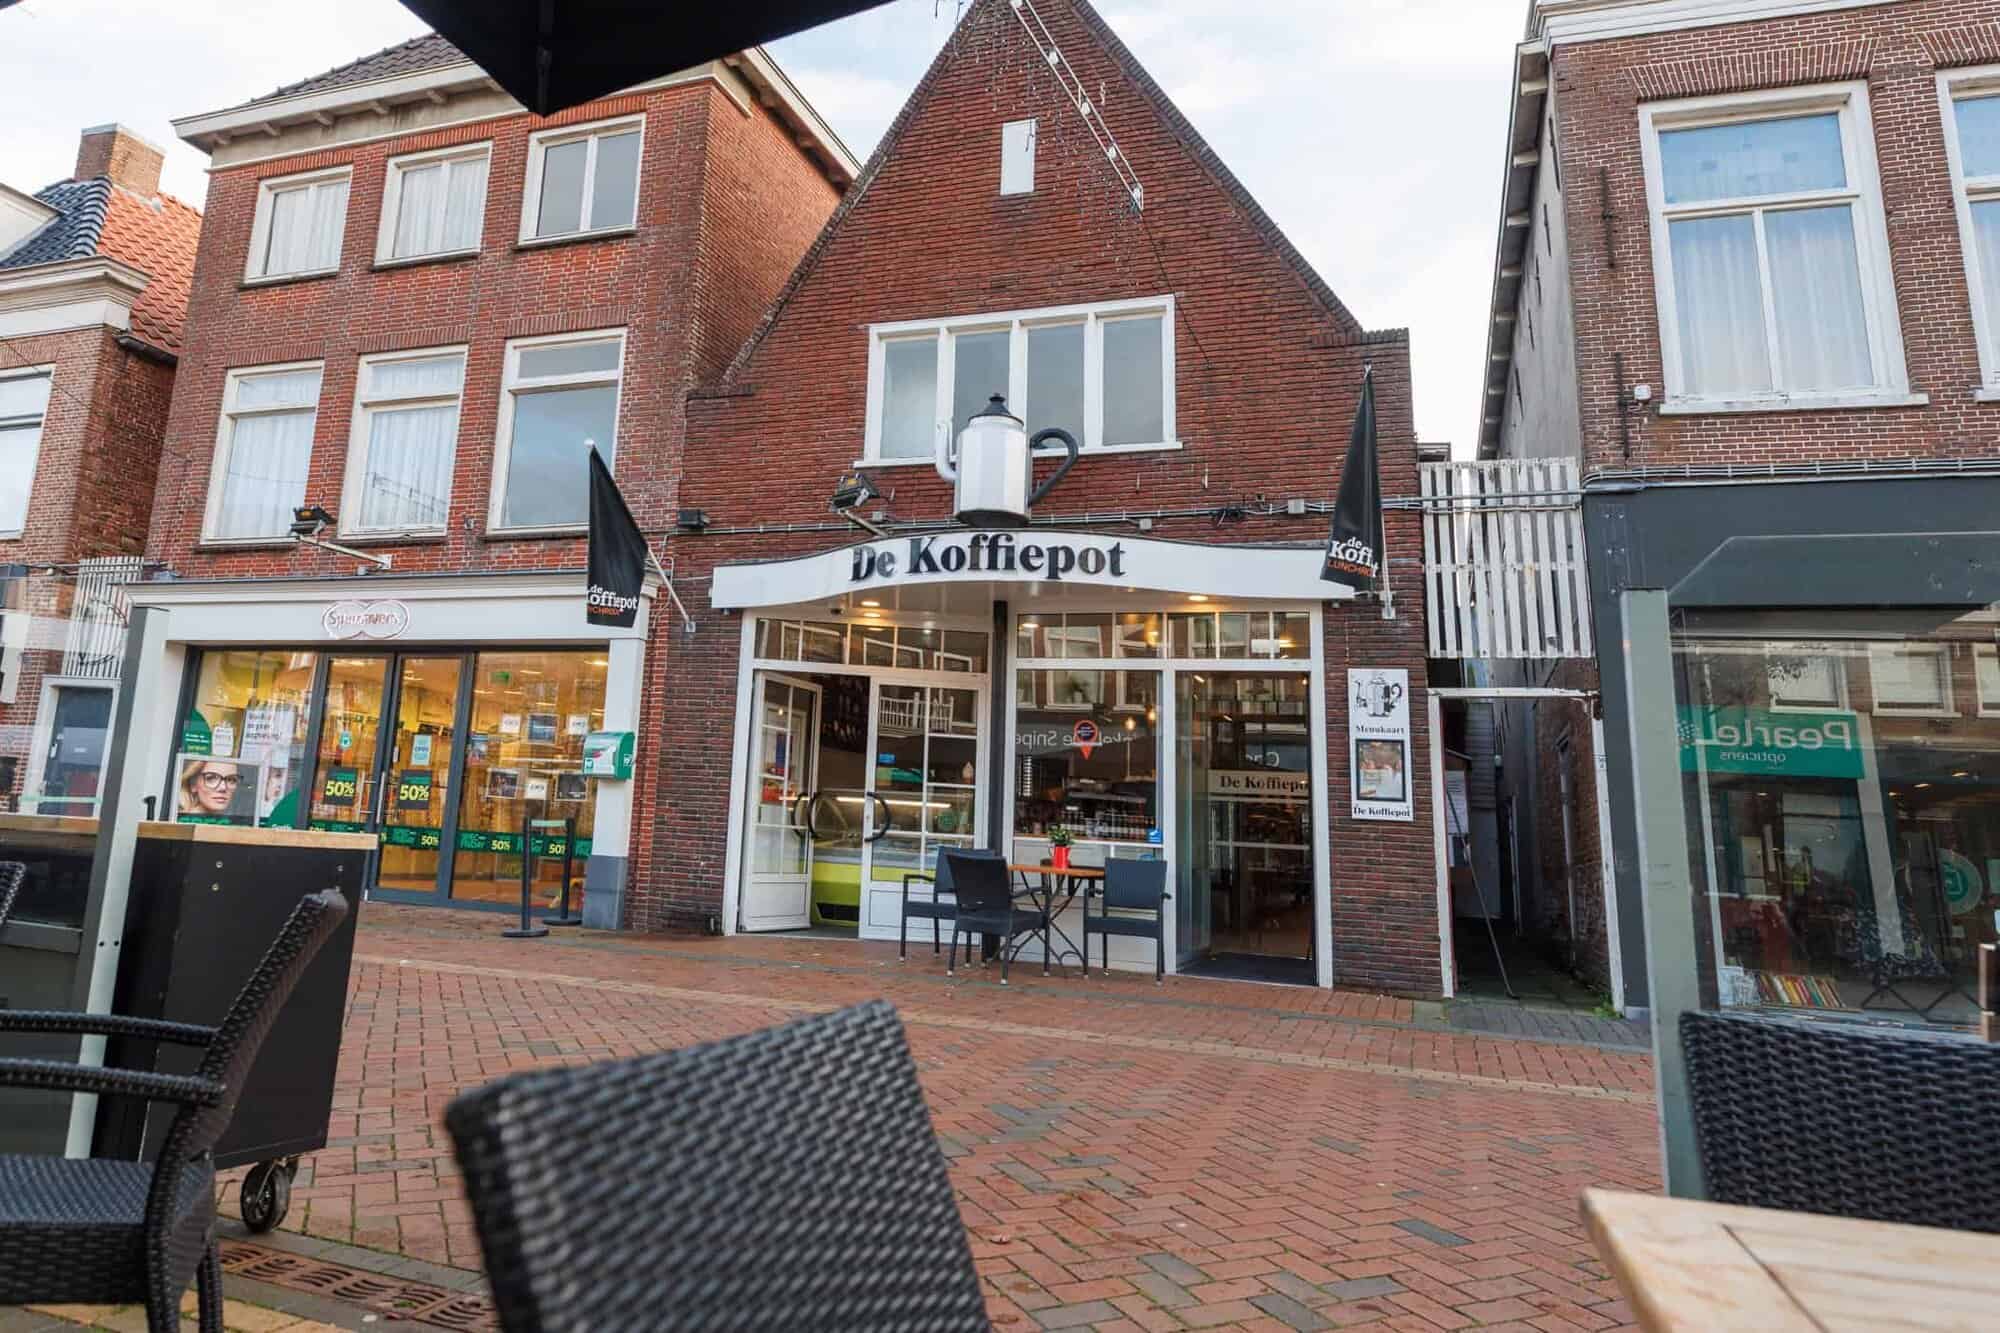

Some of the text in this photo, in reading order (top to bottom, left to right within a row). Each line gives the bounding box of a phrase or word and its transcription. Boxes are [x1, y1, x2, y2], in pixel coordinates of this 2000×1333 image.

[1347, 537, 1362, 548] de
[851, 533, 1126, 581] De Koffiepot
[590, 584, 603, 593] de
[587, 590, 637, 612] offiepot
[325, 780, 354, 797] 50%
[1221, 775, 1308, 792] De Koffiepo
[400, 785, 429, 800] 50%
[491, 839, 511, 851] 50%
